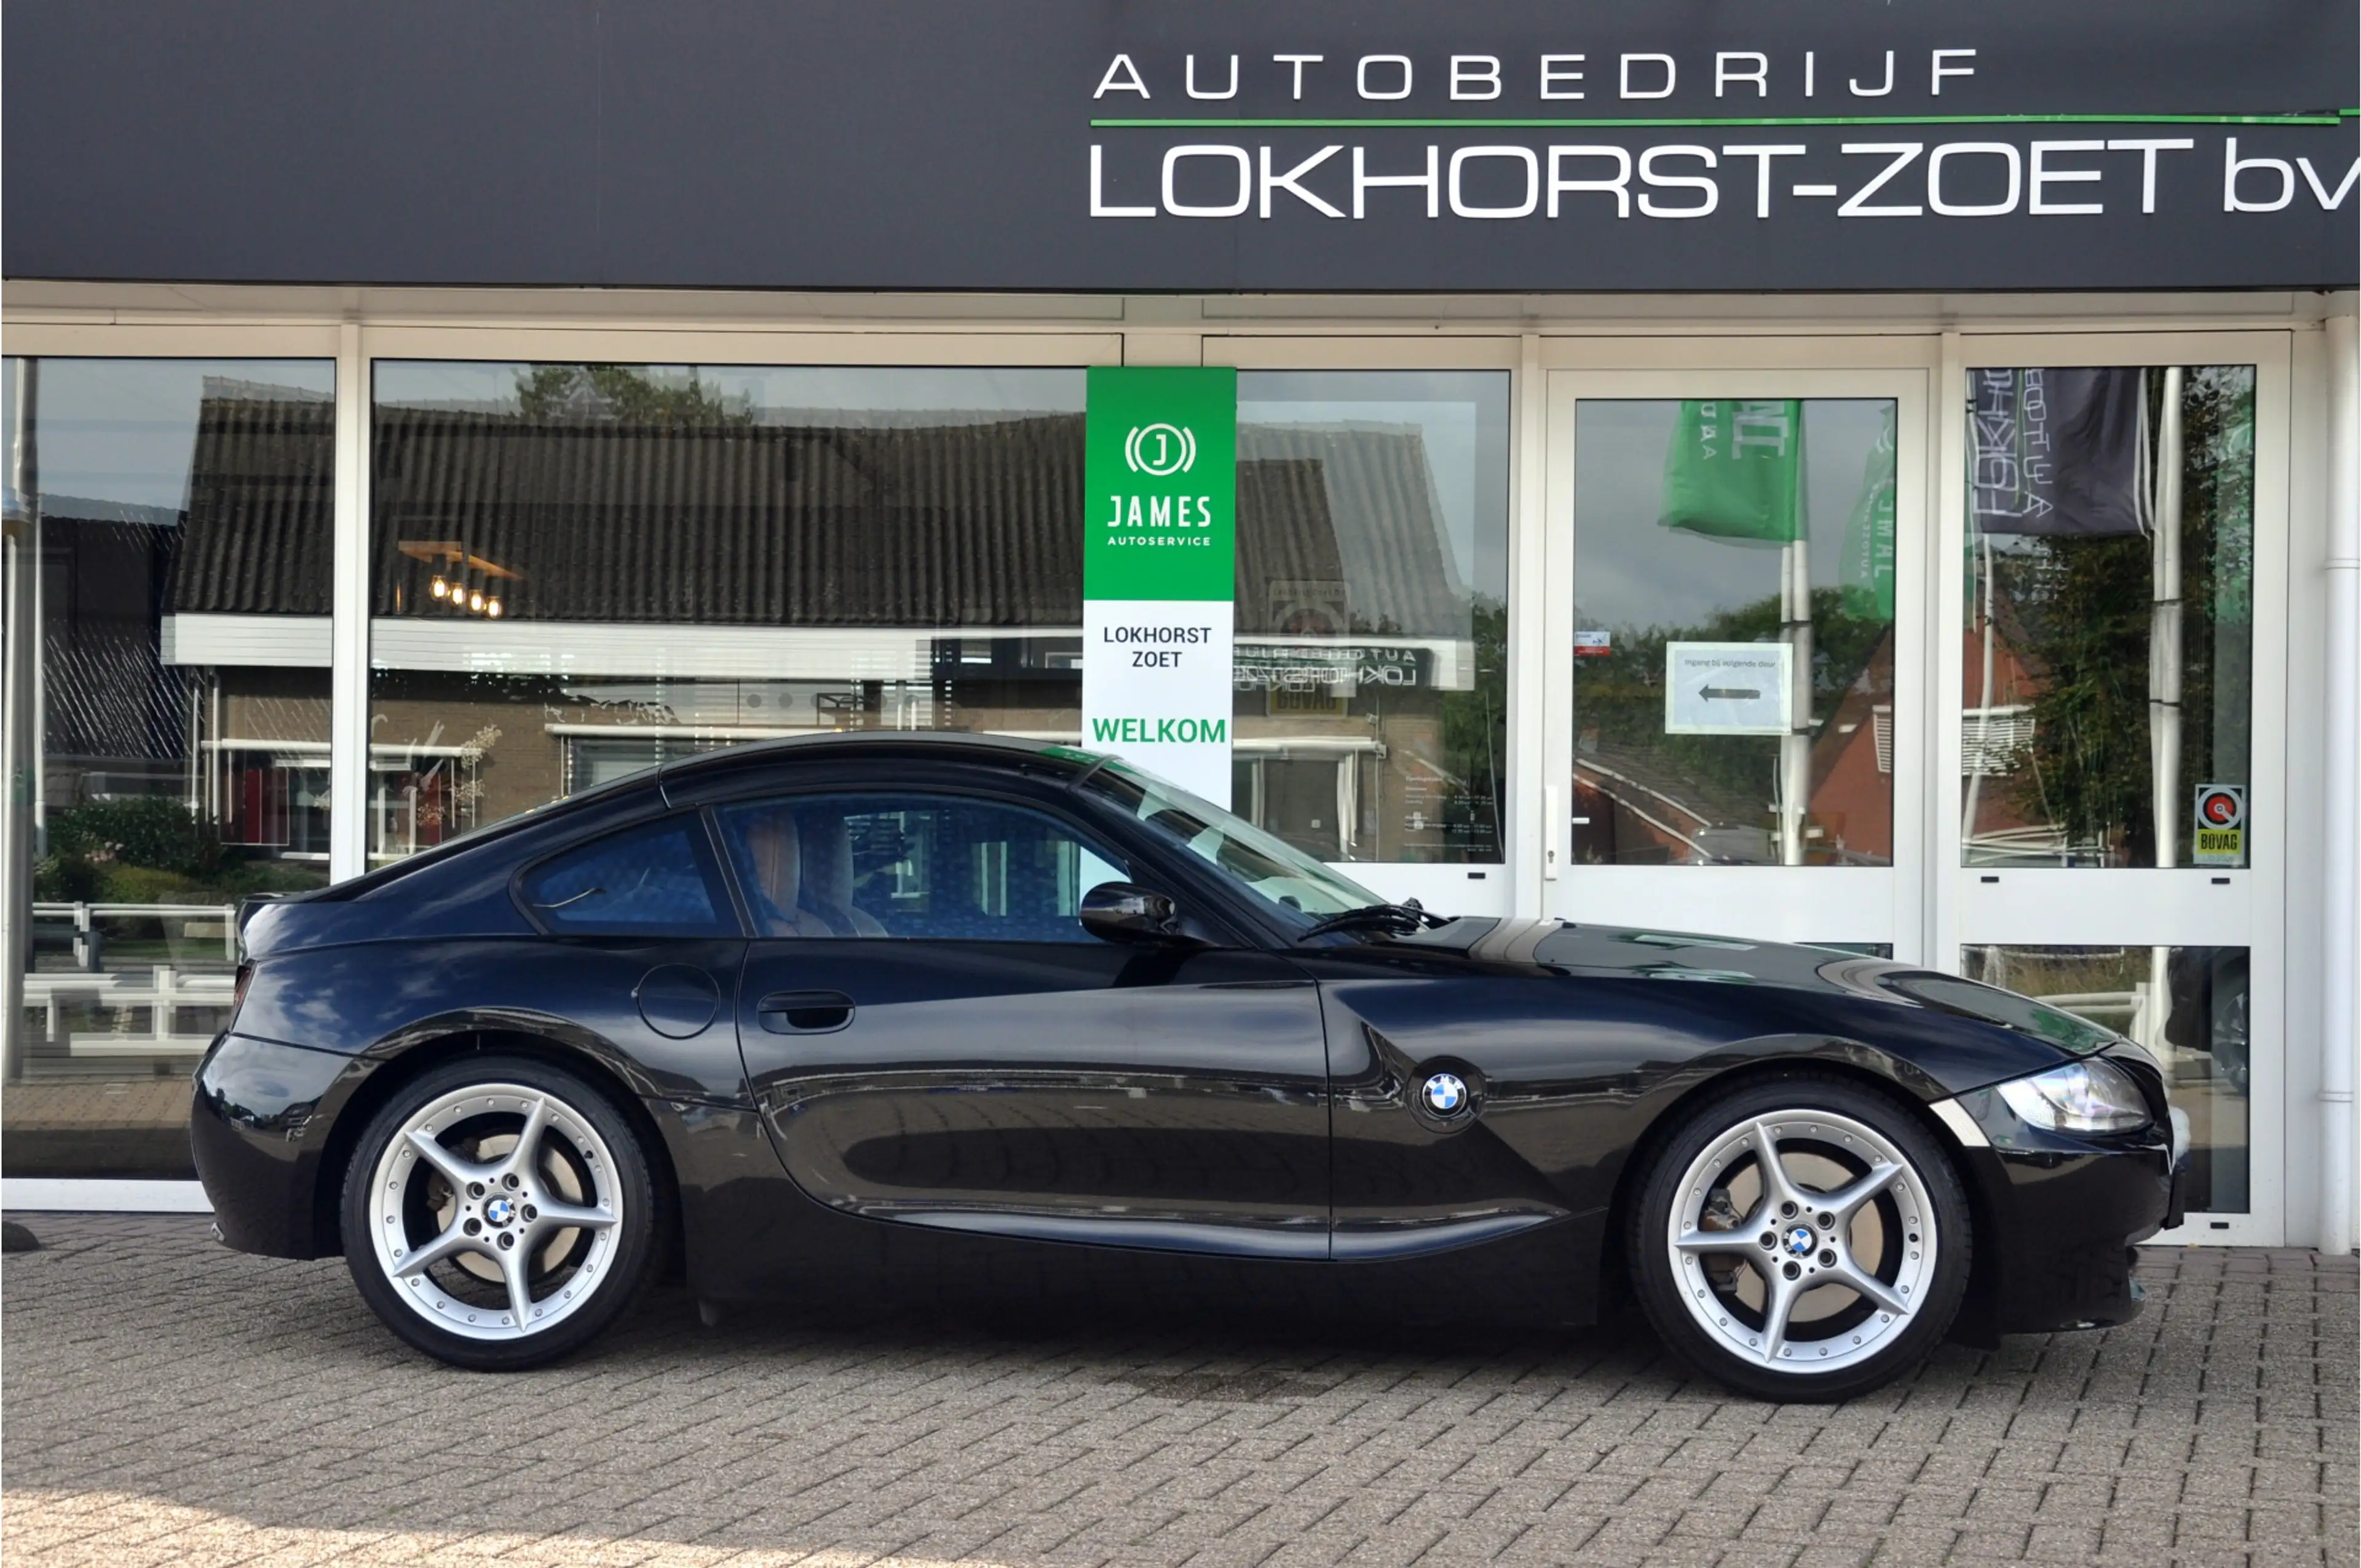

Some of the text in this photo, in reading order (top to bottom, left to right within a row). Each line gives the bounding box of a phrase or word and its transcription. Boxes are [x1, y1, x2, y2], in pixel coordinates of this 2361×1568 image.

[1092, 49, 1977, 101] AUTOBEDRIJF
[1090, 137, 2360, 220] LOKHORST-ZOET bv
[1107, 496, 1211, 528] JAMES
[1107, 537, 1211, 546] AUTOSERVICE
[1104, 627, 1212, 643] LOKHORST
[1132, 651, 1182, 667] ZOET
[1092, 718, 1226, 743] WELKOM
[2201, 833, 2237, 850] BOVAG
